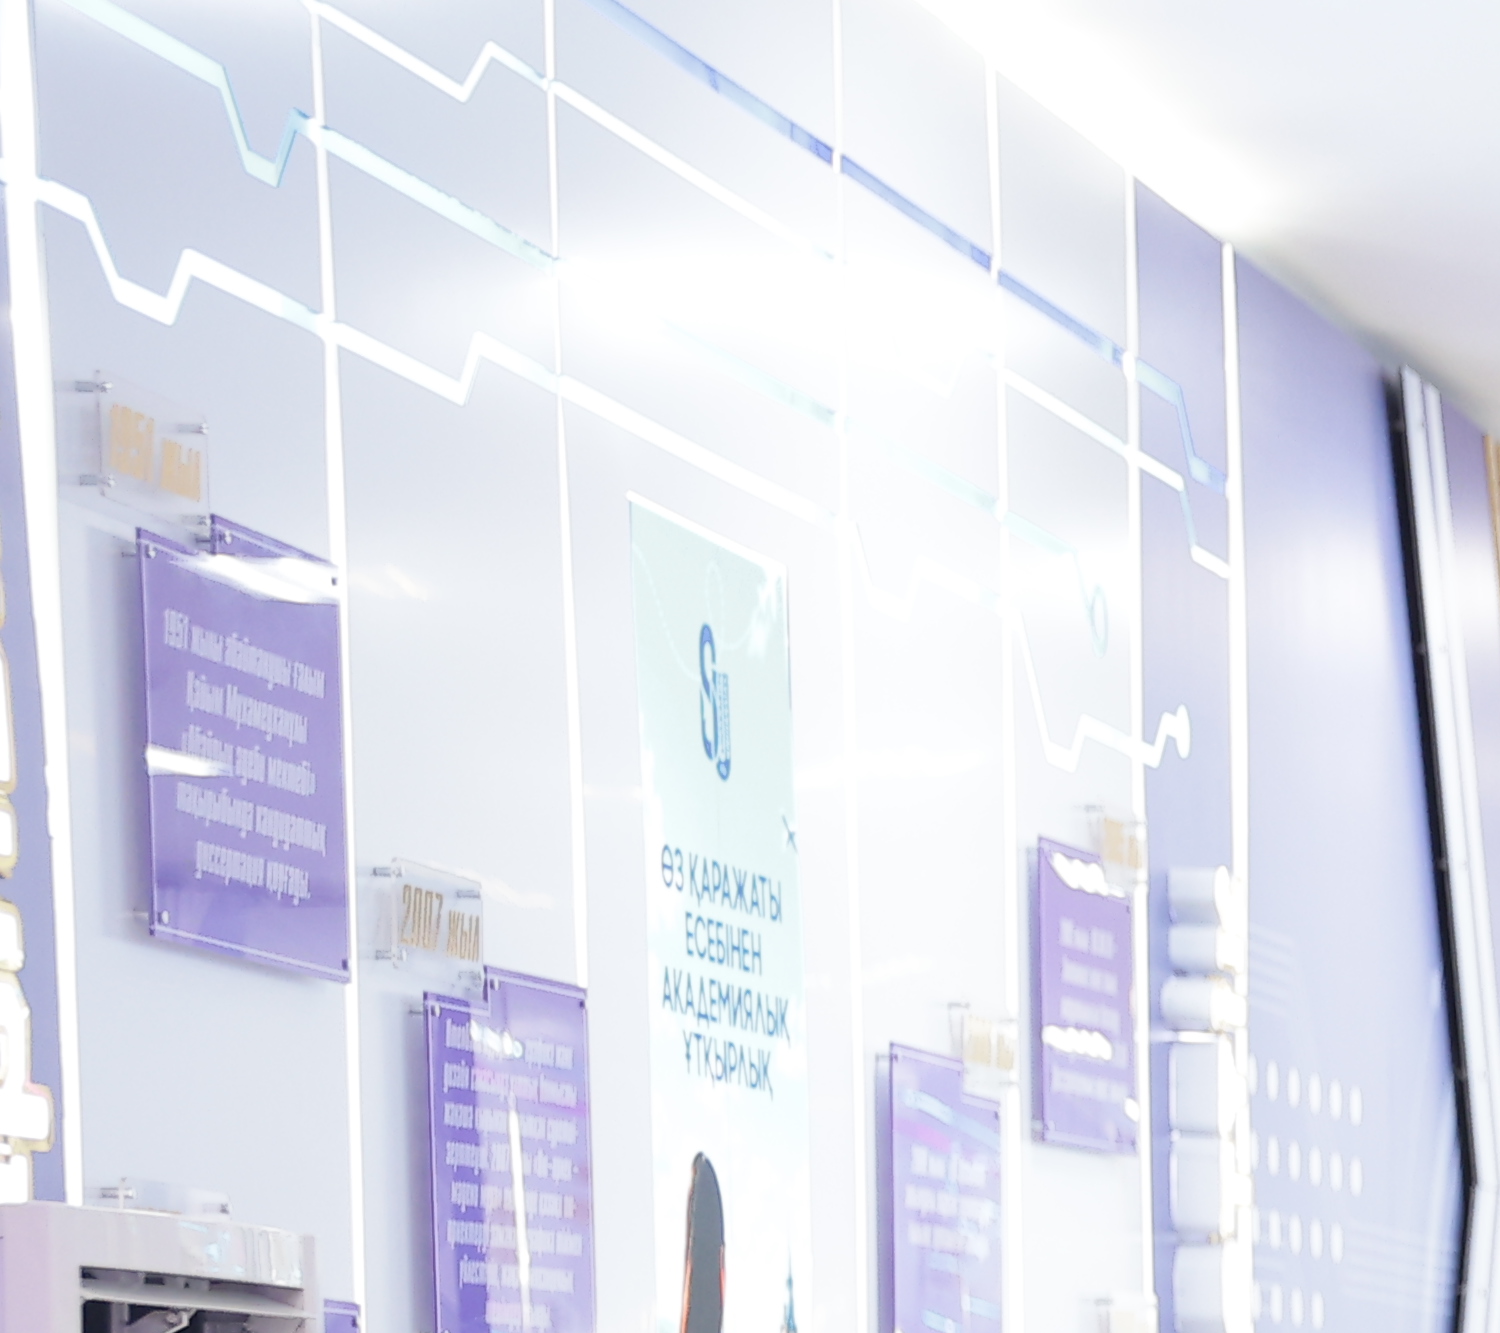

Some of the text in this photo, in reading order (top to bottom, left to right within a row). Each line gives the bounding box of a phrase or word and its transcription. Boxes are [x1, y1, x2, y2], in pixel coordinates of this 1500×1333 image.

[661, 844, 782, 924] ӨЗ ҚАРАЖАТЫ
[685, 911, 762, 976] ЕСЕБІНЕН
[662, 966, 791, 1049] АКАДЕМИЯЛЫҚ
[683, 1029, 773, 1101] ҰТҚЫРЛЫҚ
